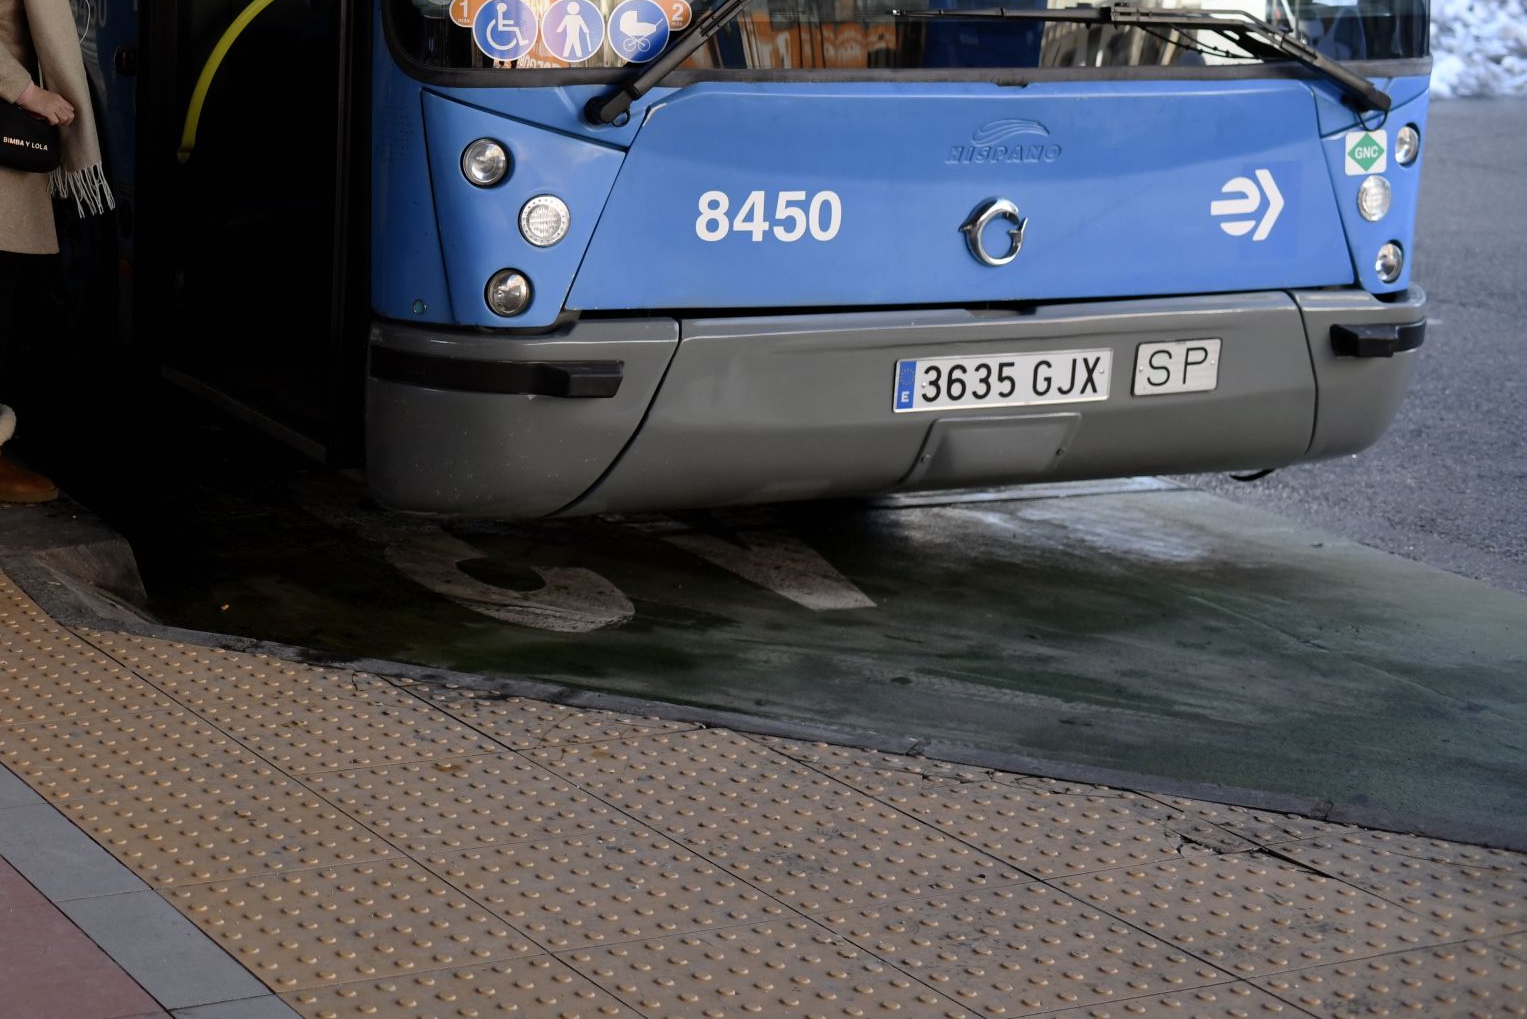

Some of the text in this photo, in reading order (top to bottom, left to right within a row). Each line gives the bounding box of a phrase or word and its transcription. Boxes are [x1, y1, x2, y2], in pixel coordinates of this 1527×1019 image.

[458, 0, 468, 18] 1
[671, 2, 684, 21] 2
[2, 136, 49, 151] BIMBA Y LOLA
[1354, 145, 1379, 160] GNC
[944, 143, 1062, 165] HISPANO
[695, 189, 842, 243] 8450
[920, 353, 1104, 404] 3635 GJX
[900, 390, 911, 404] E
